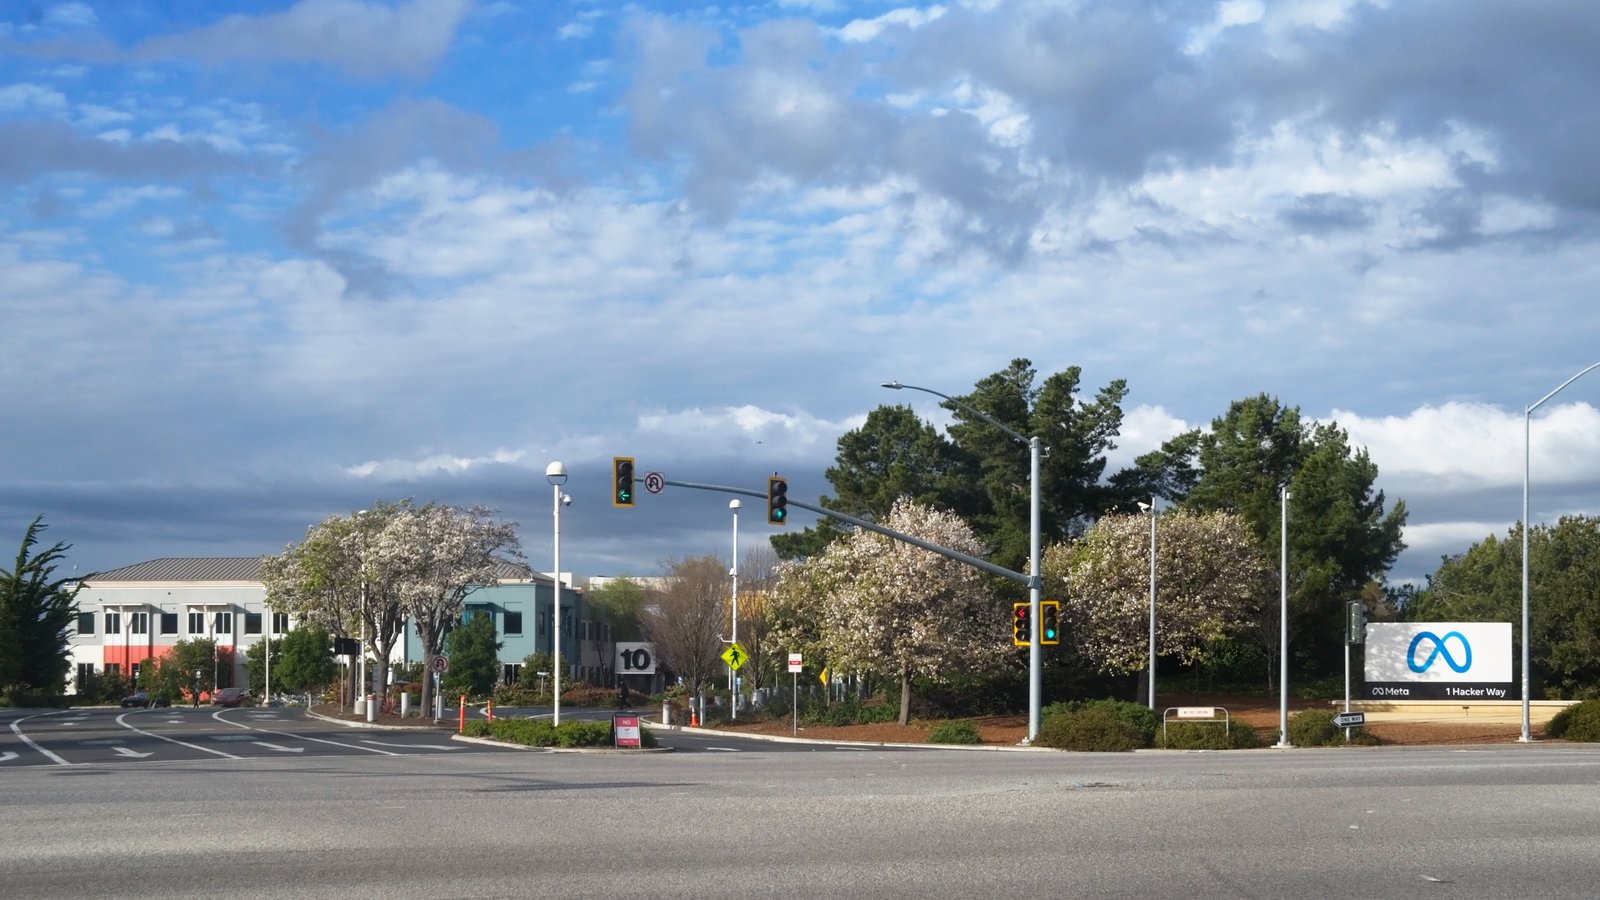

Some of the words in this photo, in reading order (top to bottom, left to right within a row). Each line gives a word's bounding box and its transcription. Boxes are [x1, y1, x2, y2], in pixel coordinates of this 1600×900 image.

[620, 648, 651, 670] 10
[1385, 687, 1409, 696] Meta
[1445, 687, 1451, 696] 1
[1452, 687, 1484, 696] Hacker
[1486, 687, 1506, 698] Way
